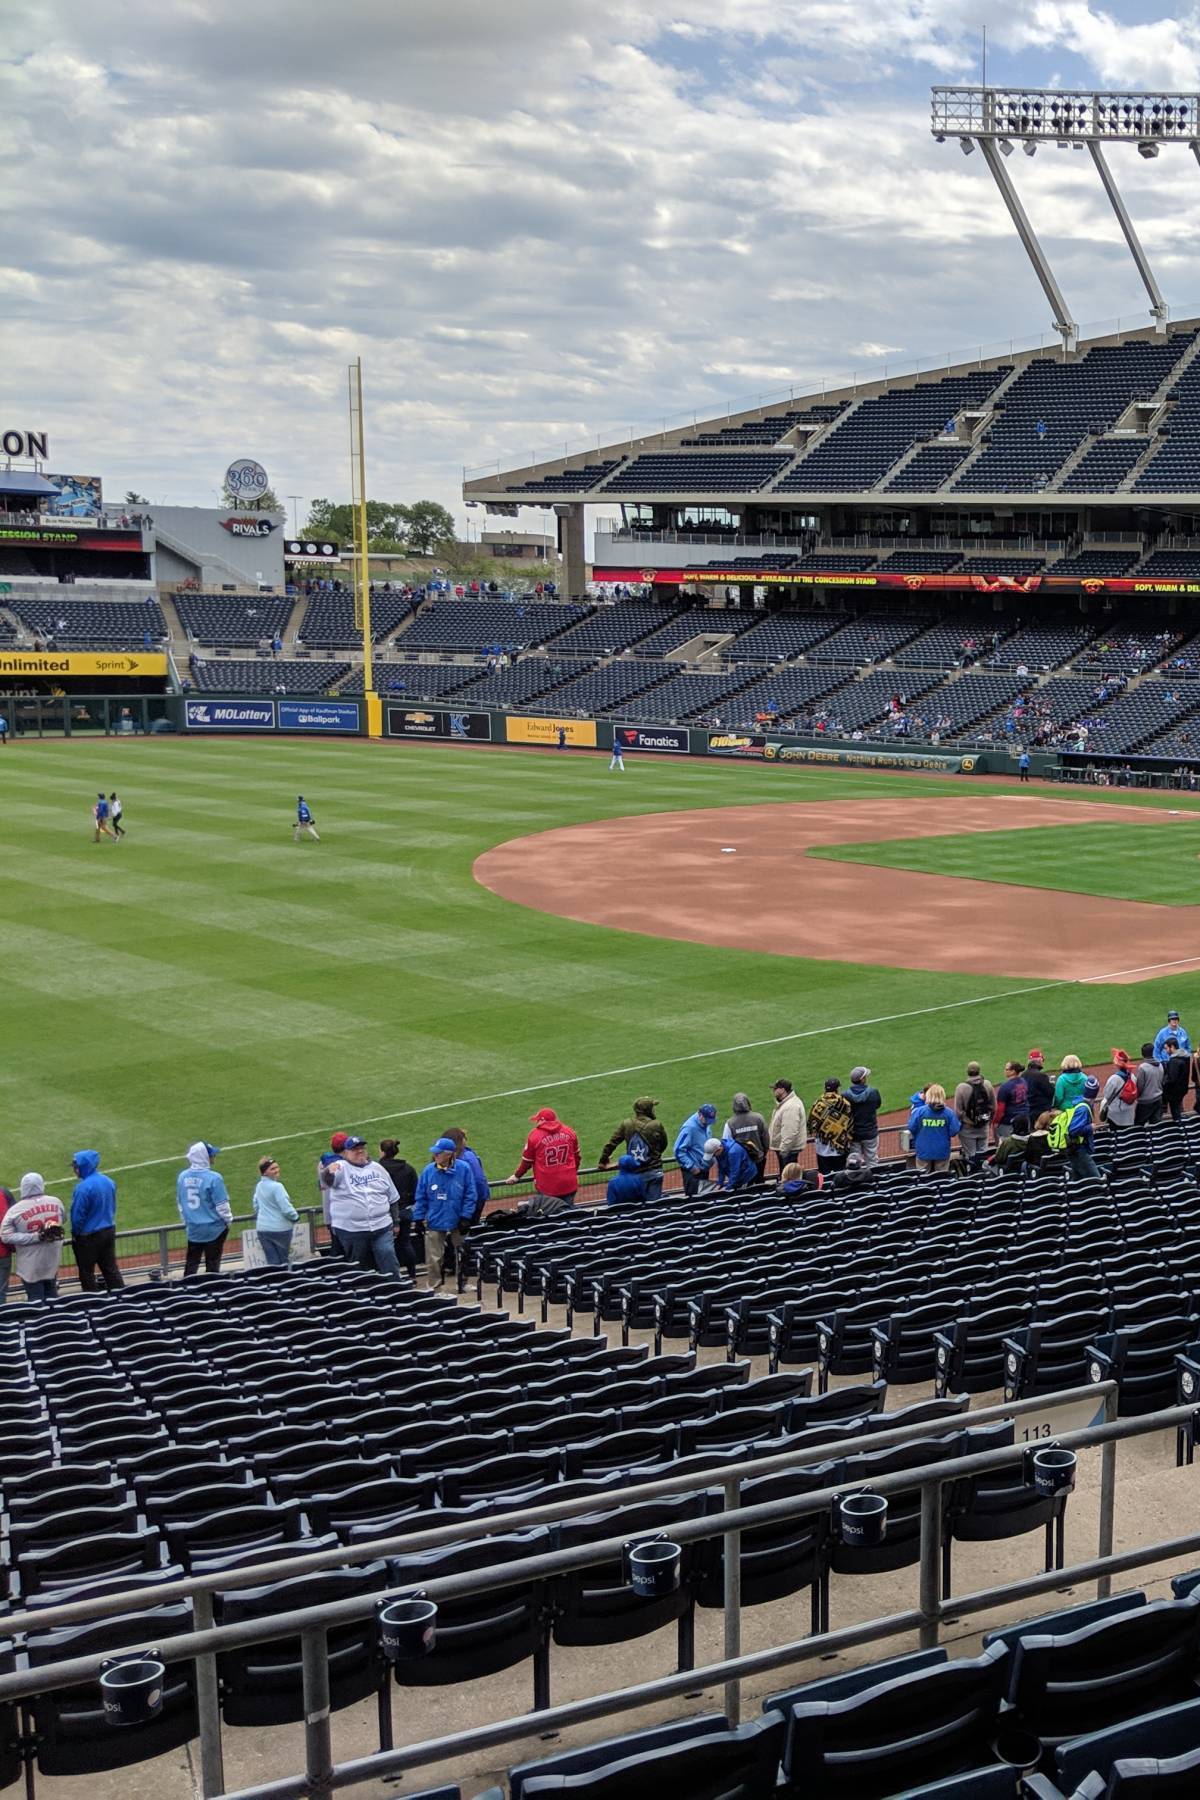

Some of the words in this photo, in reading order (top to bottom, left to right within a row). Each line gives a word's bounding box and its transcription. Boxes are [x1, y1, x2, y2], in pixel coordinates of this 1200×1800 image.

[228, 466, 266, 490] 360
[232, 523, 270, 534] RIVALS
[43, 532, 77, 541] STAND
[1135, 584, 1153, 592] SOFT,
[1180, 584, 1185, 592] &
[96, 660, 125, 670] Sprint
[215, 708, 271, 722] MOLottery
[308, 714, 341, 724] Ballpark
[404, 725, 436, 733] CHEVROLET
[527, 722, 551, 732] Edward
[639, 734, 679, 748] Fanatics
[780, 750, 805, 760] JOHN
[808, 751, 840, 762] DEERE
[923, 1118, 946, 1127] STAFF
[545, 1144, 569, 1167] 27
[187, 1188, 200, 1210] 5
[1023, 1424, 1051, 1442] 113
